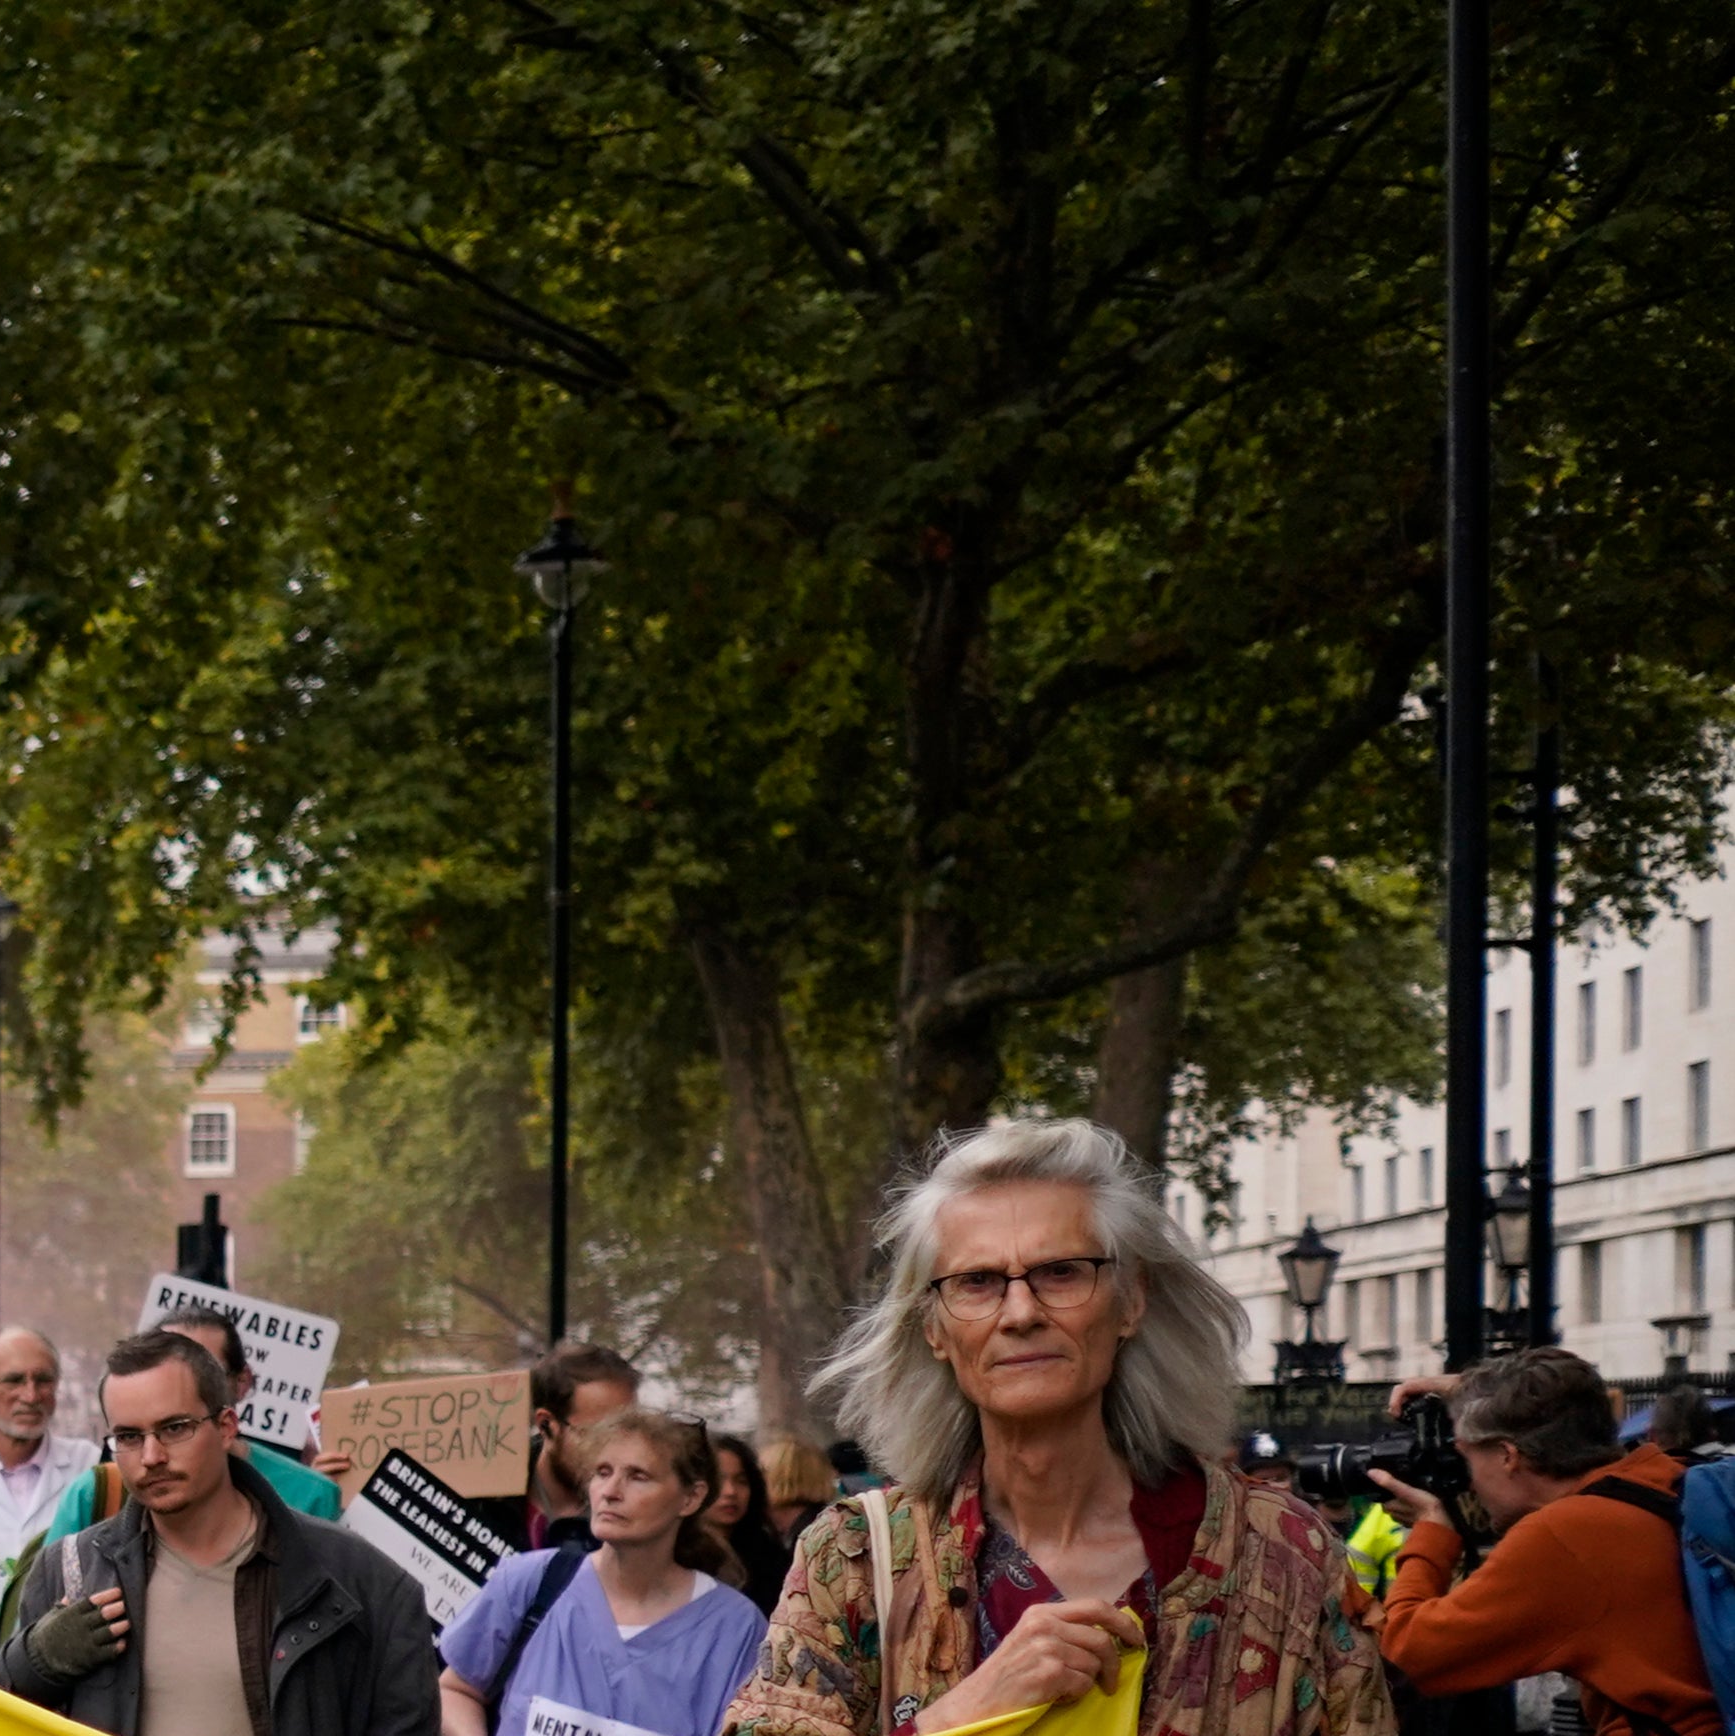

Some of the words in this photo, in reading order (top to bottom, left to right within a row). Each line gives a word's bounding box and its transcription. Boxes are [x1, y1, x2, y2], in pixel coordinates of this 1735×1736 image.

[157, 1287, 324, 1350] RENEWABLES
[243, 1346, 271, 1363] OW
[252, 1375, 312, 1404] EAPER
[350, 1390, 480, 1428] #STOP
[240, 1404, 289, 1434] AS!
[372, 1478, 401, 1506] THE
[400, 1501, 467, 1556] LEAKIEST
[466, 1553, 486, 1573] IN
[387, 1457, 466, 1525] BRITAIN'S
[465, 1517, 519, 1558] HOME
[408, 1546, 432, 1569] WE
[439, 1573, 470, 1597] ARE
